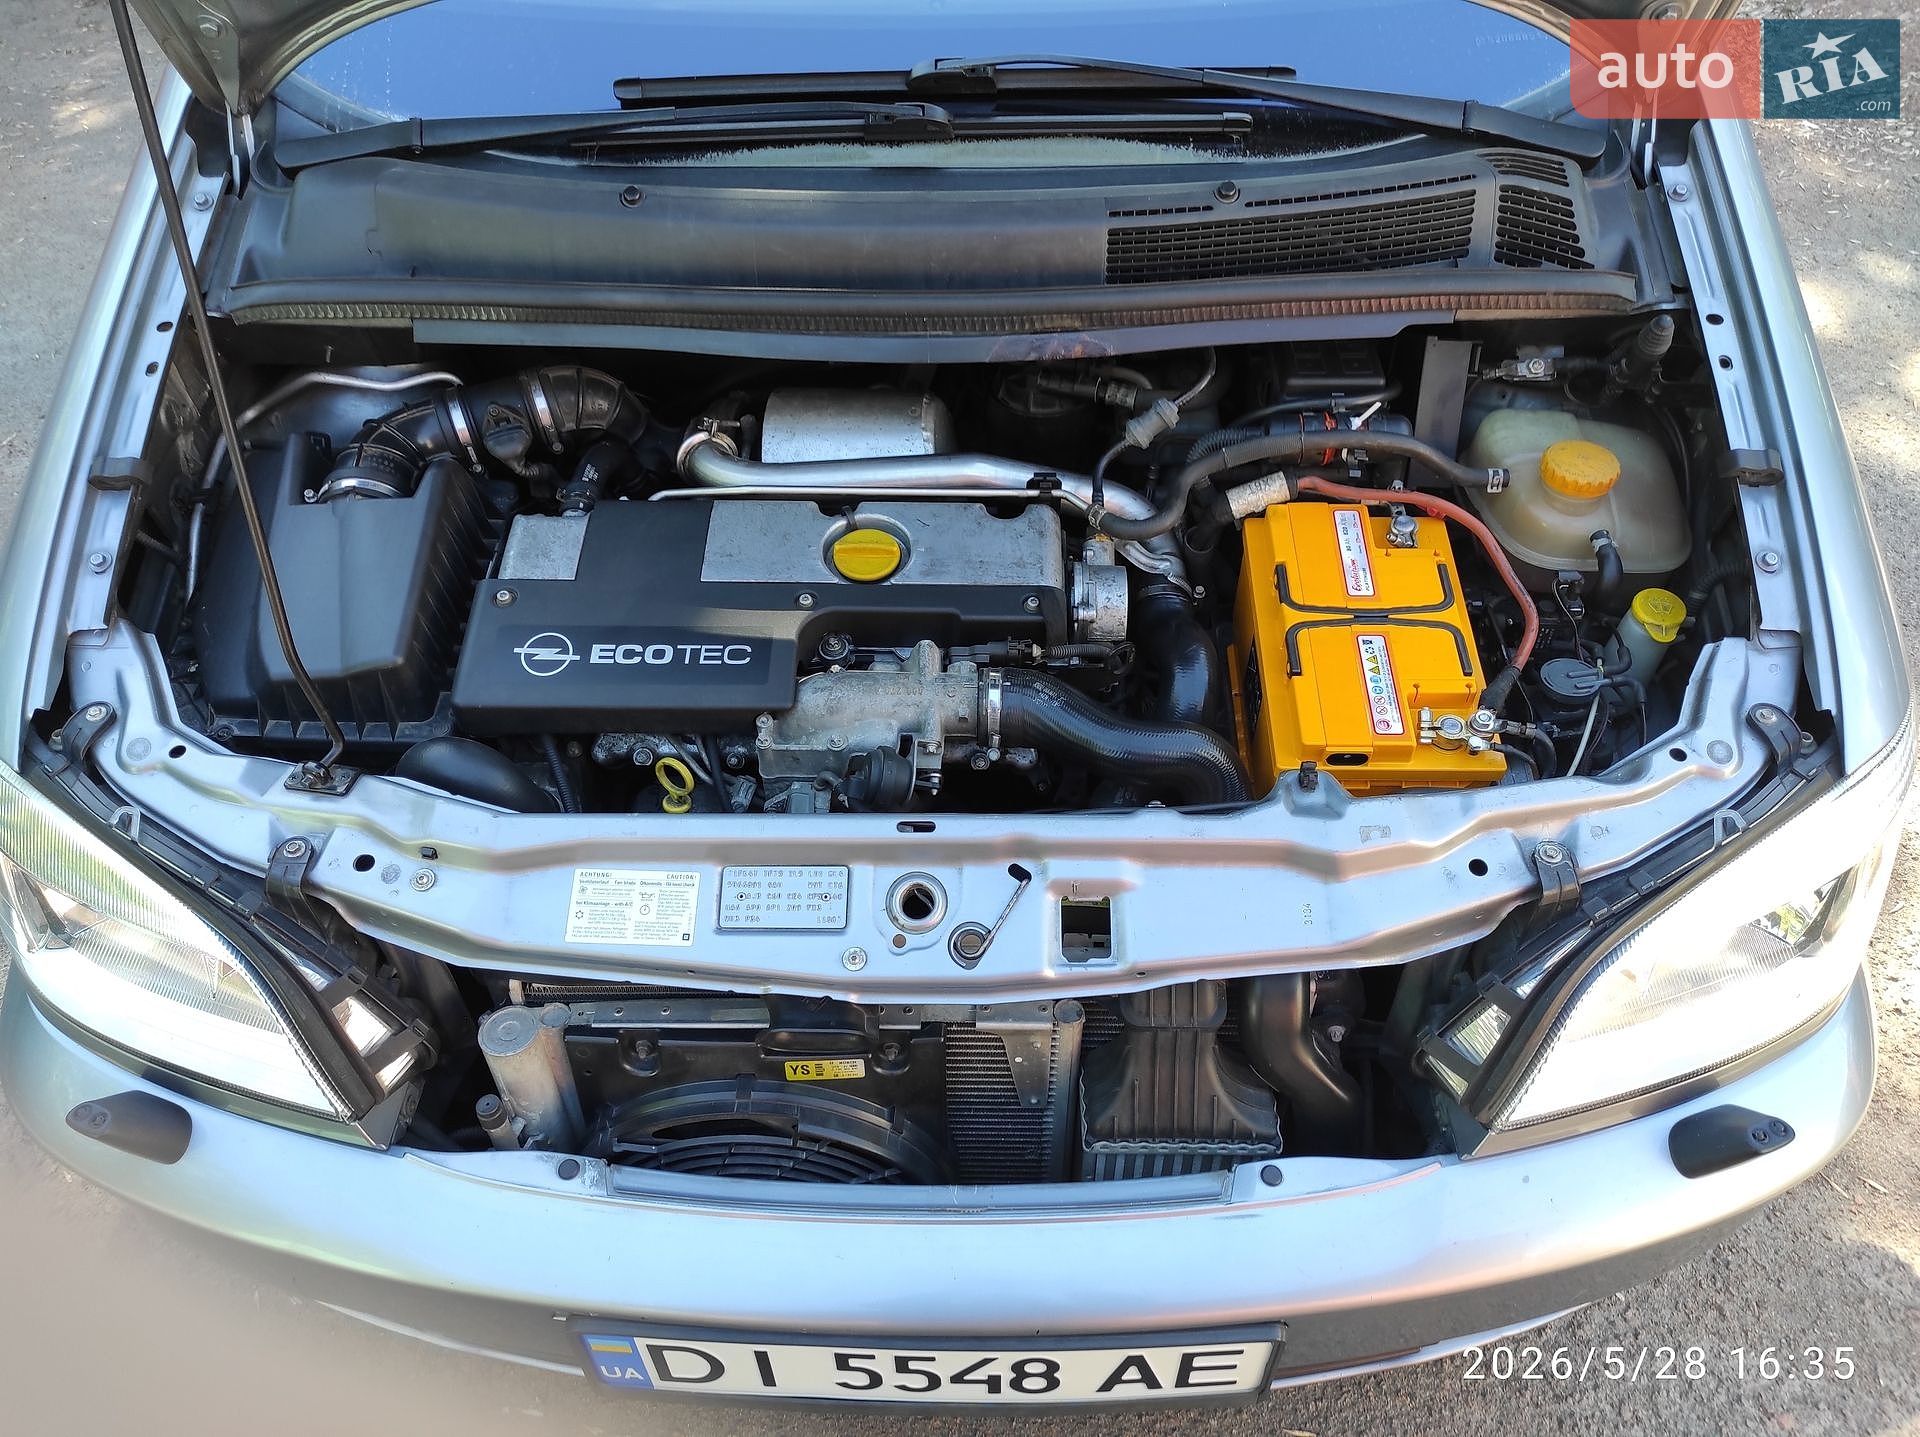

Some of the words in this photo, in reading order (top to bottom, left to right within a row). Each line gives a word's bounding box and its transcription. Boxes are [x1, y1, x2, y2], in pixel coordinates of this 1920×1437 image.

[589, 644, 752, 665] ECOTEC
[789, 1064, 811, 1075] YS
[598, 1365, 645, 1382] UA
[645, 1344, 777, 1388] DI
[834, 1353, 1061, 1395] 5548
[1096, 1350, 1246, 1393] AE
